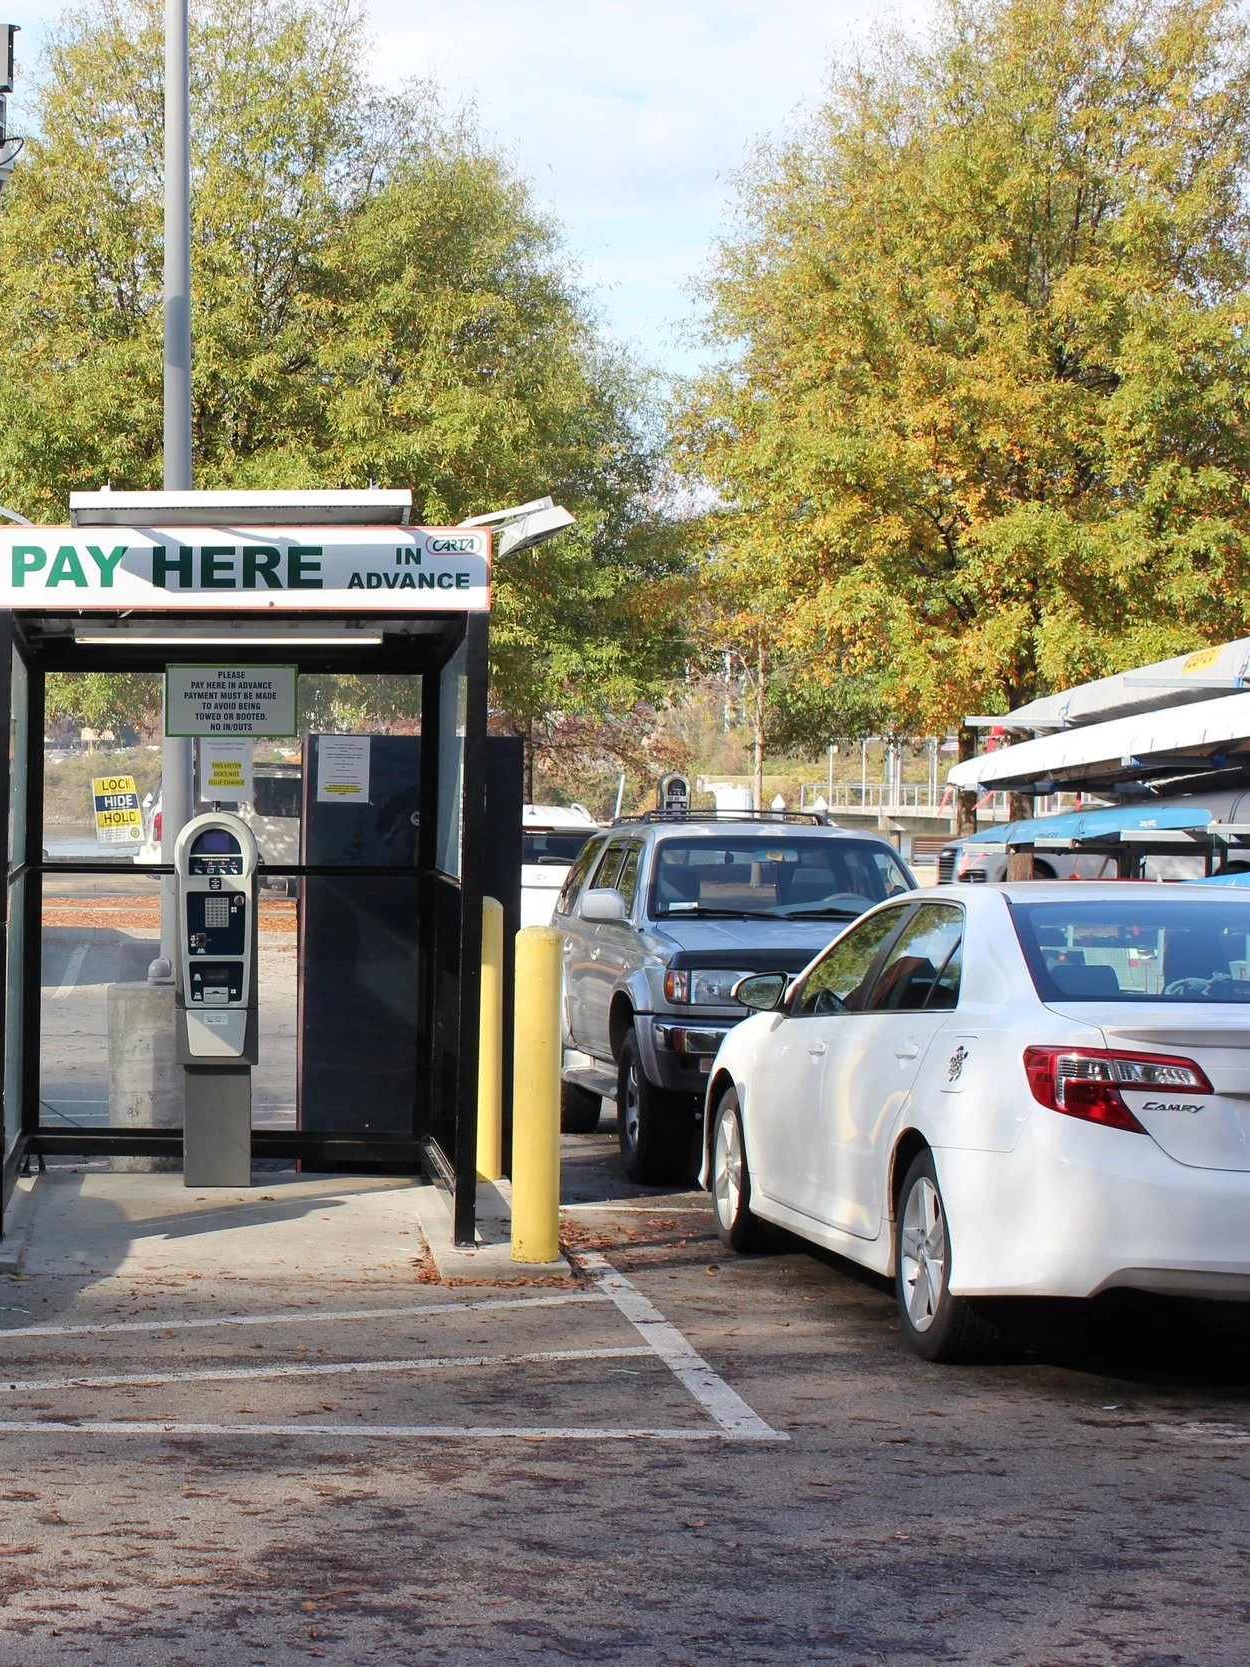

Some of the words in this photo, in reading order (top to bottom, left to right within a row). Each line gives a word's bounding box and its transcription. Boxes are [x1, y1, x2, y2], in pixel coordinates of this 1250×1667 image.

[432, 539, 475, 552] CARTA
[395, 547, 422, 565] IN
[11, 545, 129, 588] PAY
[151, 545, 324, 590] HERE
[347, 572, 471, 590] ADVANCE
[217, 671, 246, 679] PLEASE
[191, 681, 205, 690] PAY
[206, 681, 227, 690] HERE
[228, 681, 236, 690] IN
[238, 681, 273, 690] ADVANCE
[184, 692, 218, 700] PAYMENT
[220, 692, 242, 700] MUST
[243, 692, 254, 700] BE
[255, 692, 277, 700] MADE
[202, 702, 212, 711] TO
[213, 702, 237, 711] AVOID
[238, 702, 261, 711] BEING
[195, 712, 222, 721] TOWED
[223, 712, 234, 721] OR
[236, 712, 268, 721] BOOTED.
[210, 723, 221, 731] NO
[222, 723, 253, 731] IN/OUTS
[104, 795, 134, 808] HIDE
[104, 812, 137, 824] HOLD
